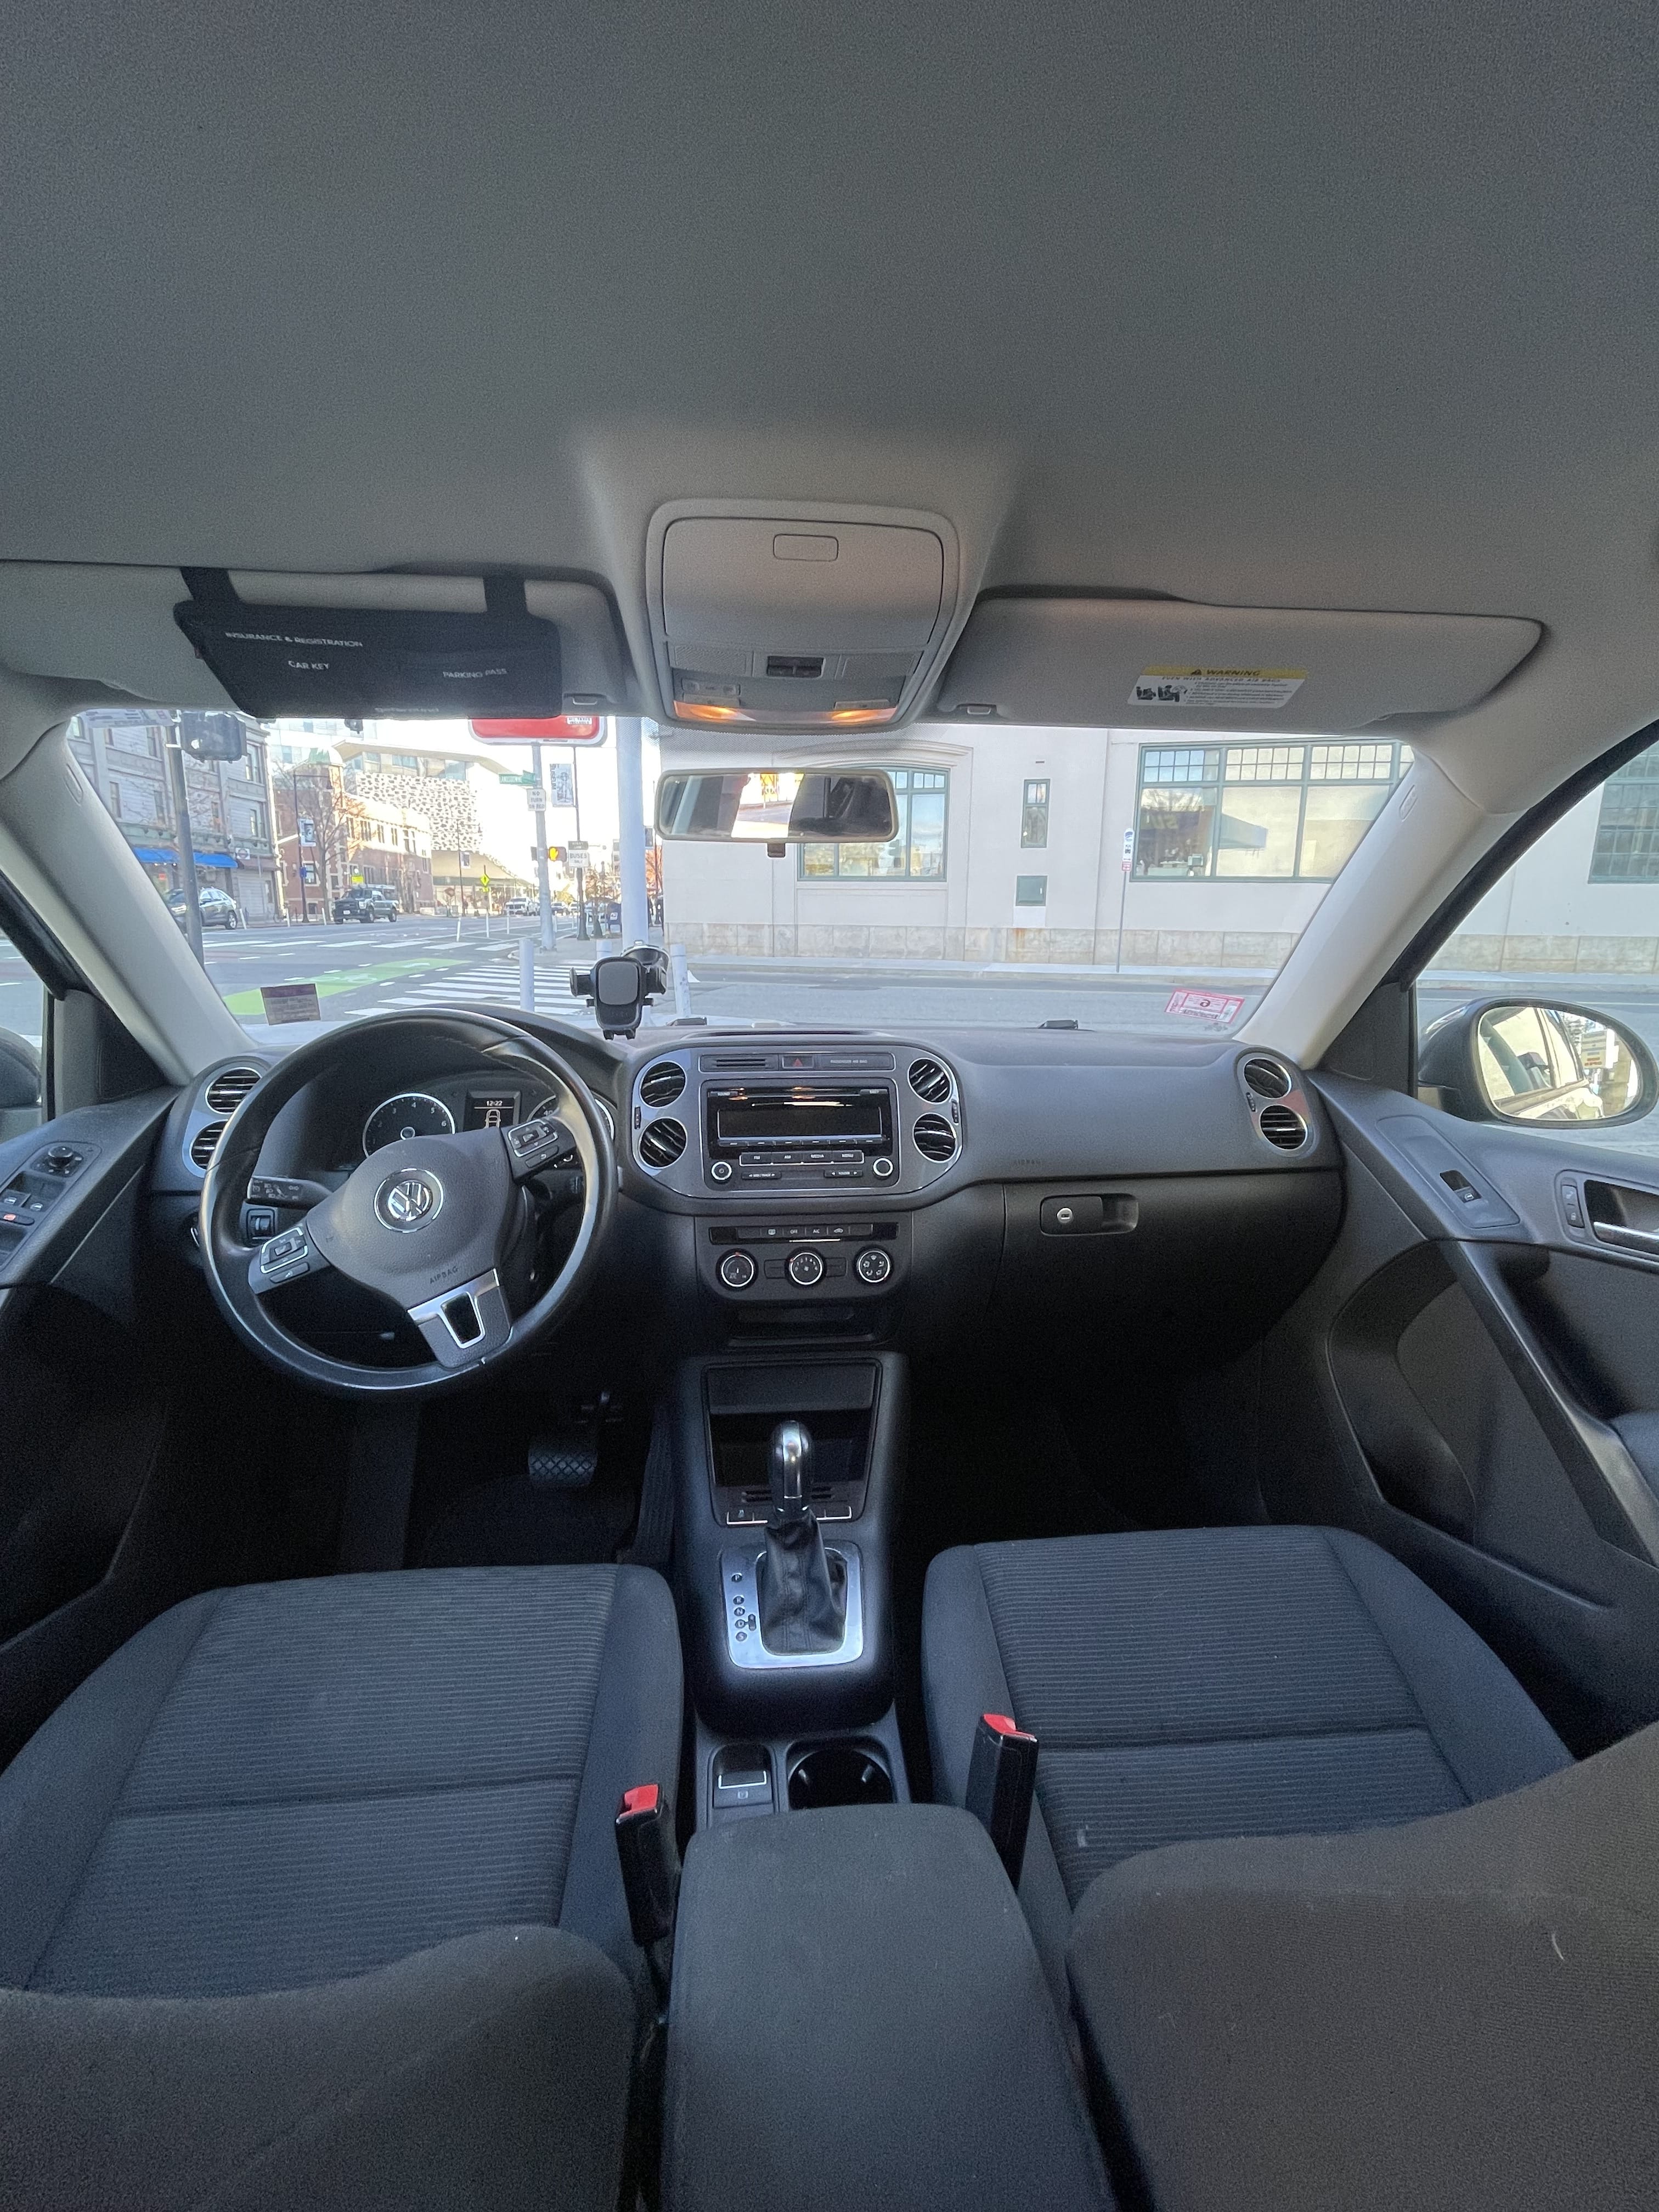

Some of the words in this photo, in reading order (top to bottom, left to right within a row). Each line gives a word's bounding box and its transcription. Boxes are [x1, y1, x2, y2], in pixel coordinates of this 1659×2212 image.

[225, 632, 282, 641] INSURANCE
[294, 637, 363, 647] REGISTRATION
[288, 660, 310, 669] CAR
[430, 1265, 459, 1284] AIRBAG
